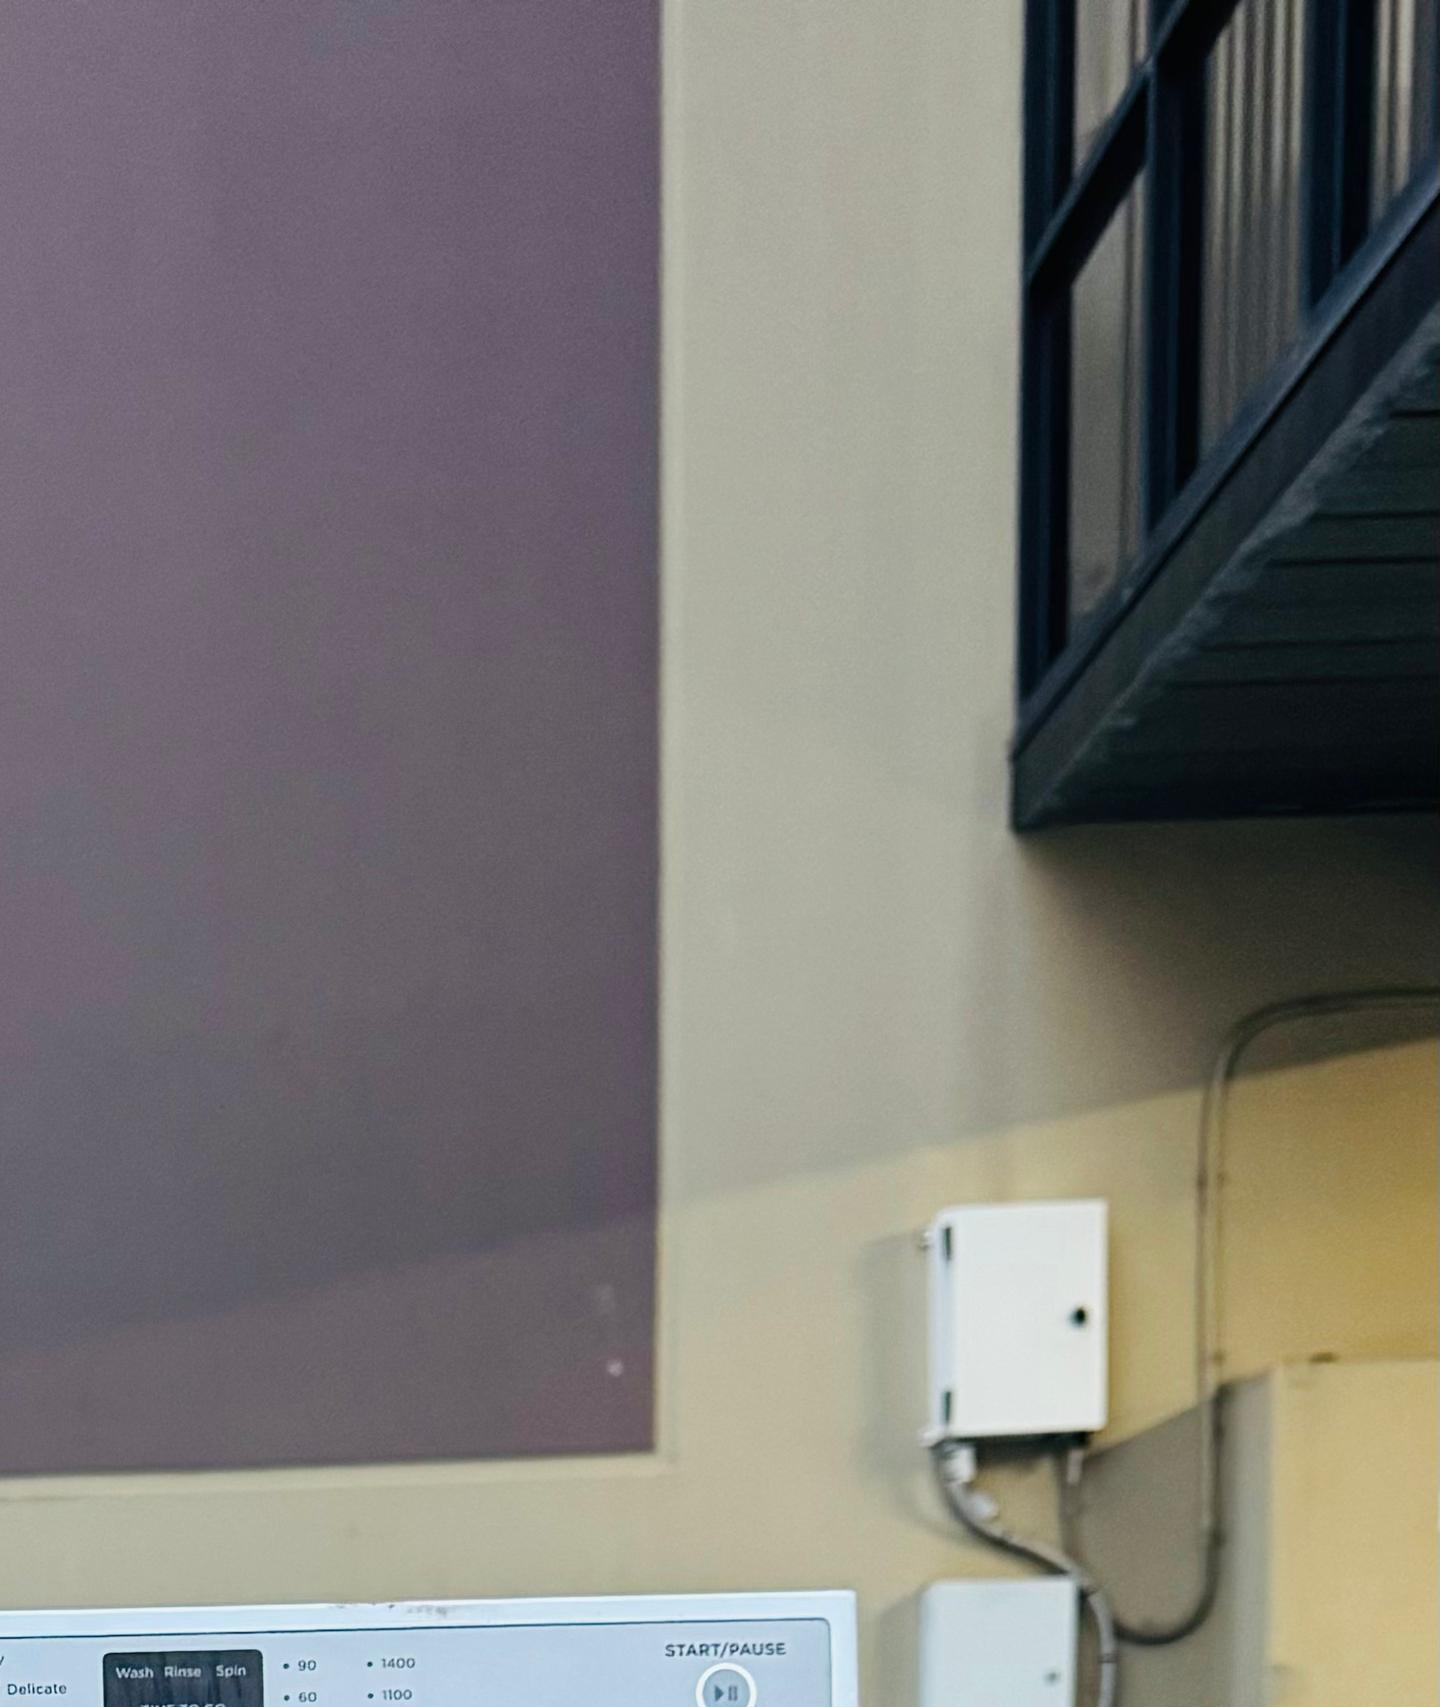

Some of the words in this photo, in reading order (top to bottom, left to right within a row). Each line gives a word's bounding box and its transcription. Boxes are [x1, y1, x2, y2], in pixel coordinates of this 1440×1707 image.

[665, 1643, 787, 1657] START/PAUSE
[298, 1660, 317, 1671] 90
[381, 1658, 416, 1669] 1400
[116, 1667, 154, 1679] Wash
[164, 1666, 202, 1678] Rinse
[216, 1665, 247, 1678] Spin
[7, 1683, 67, 1696] Delicate
[382, 1689, 413, 1701] 1100
[298, 1691, 318, 1703] 60
